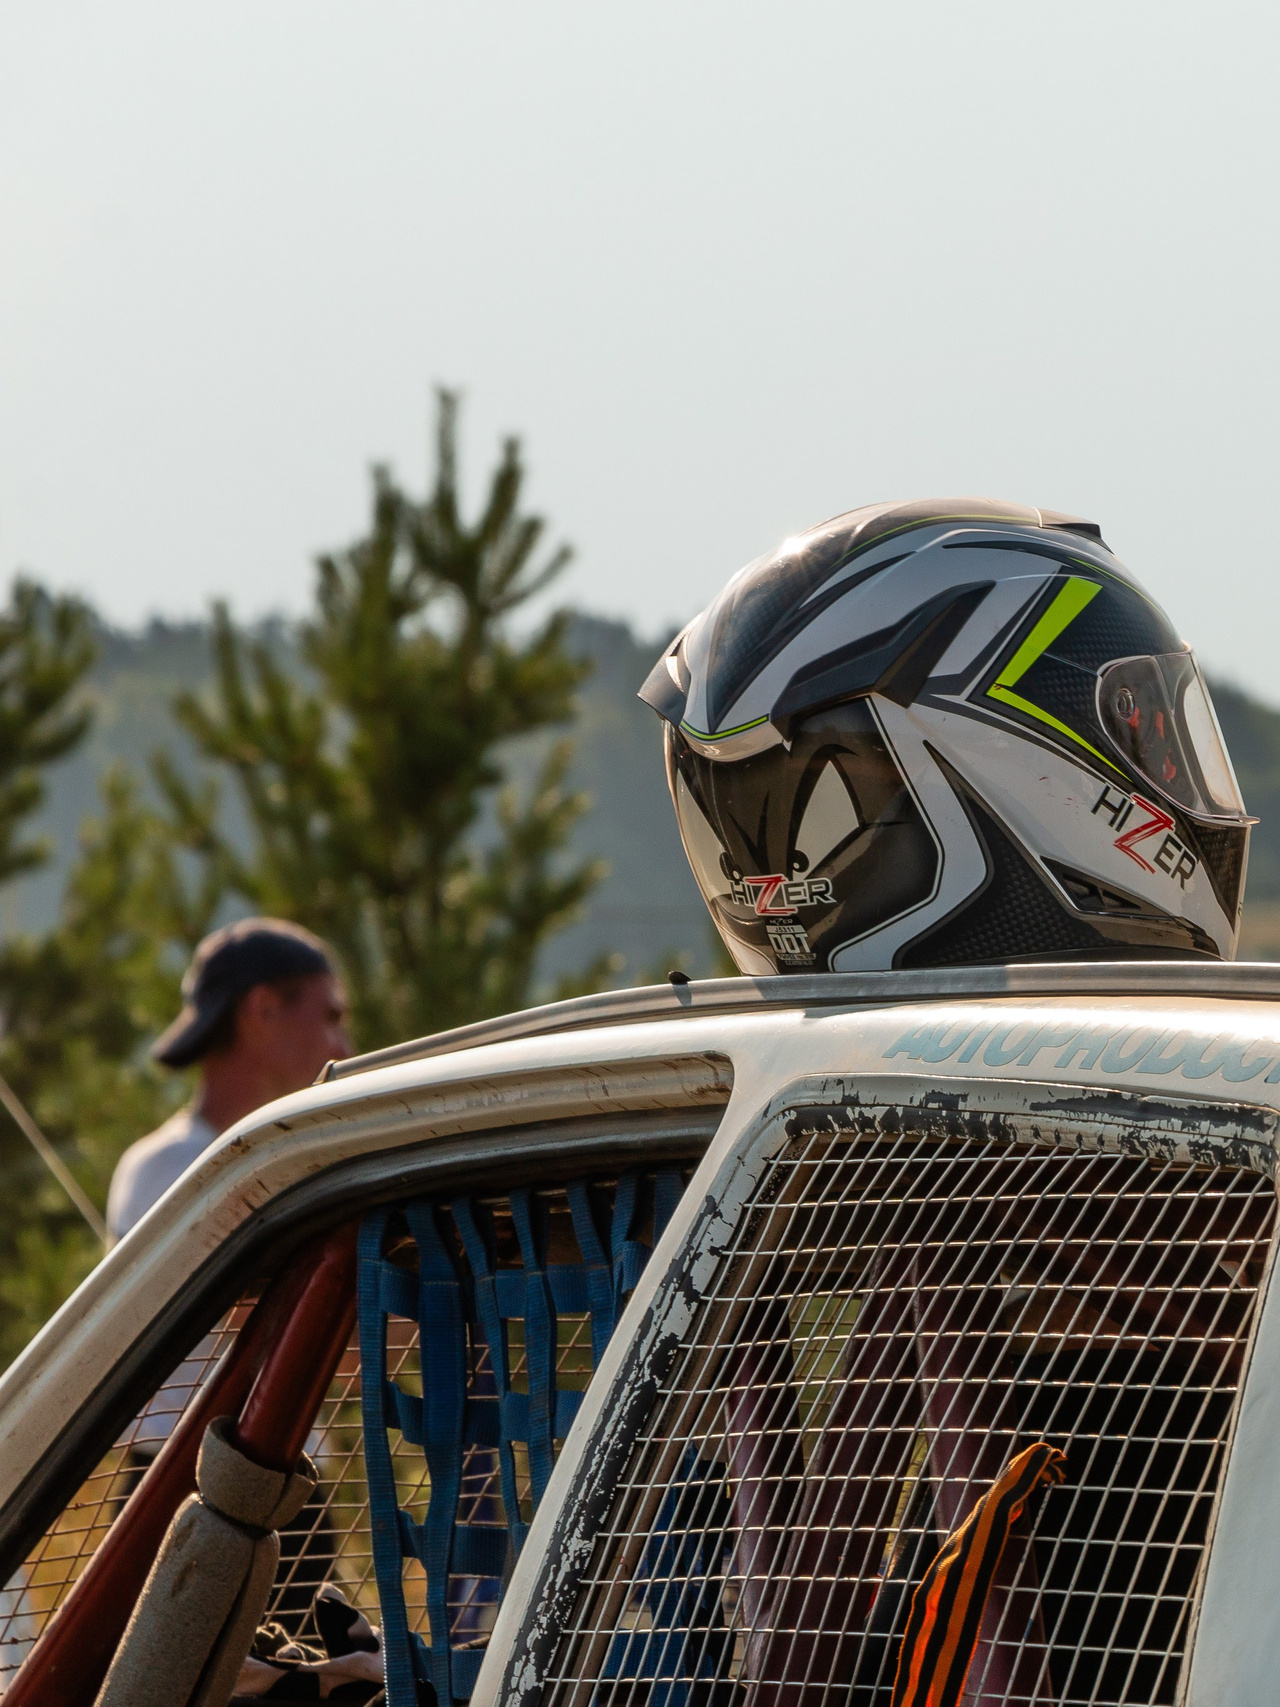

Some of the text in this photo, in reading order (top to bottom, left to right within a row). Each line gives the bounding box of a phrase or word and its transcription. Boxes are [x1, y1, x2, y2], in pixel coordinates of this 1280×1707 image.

[1091, 784, 1197, 890] HIZER
[729, 874, 837, 916] HIZER
[768, 933, 811, 954] DOT
